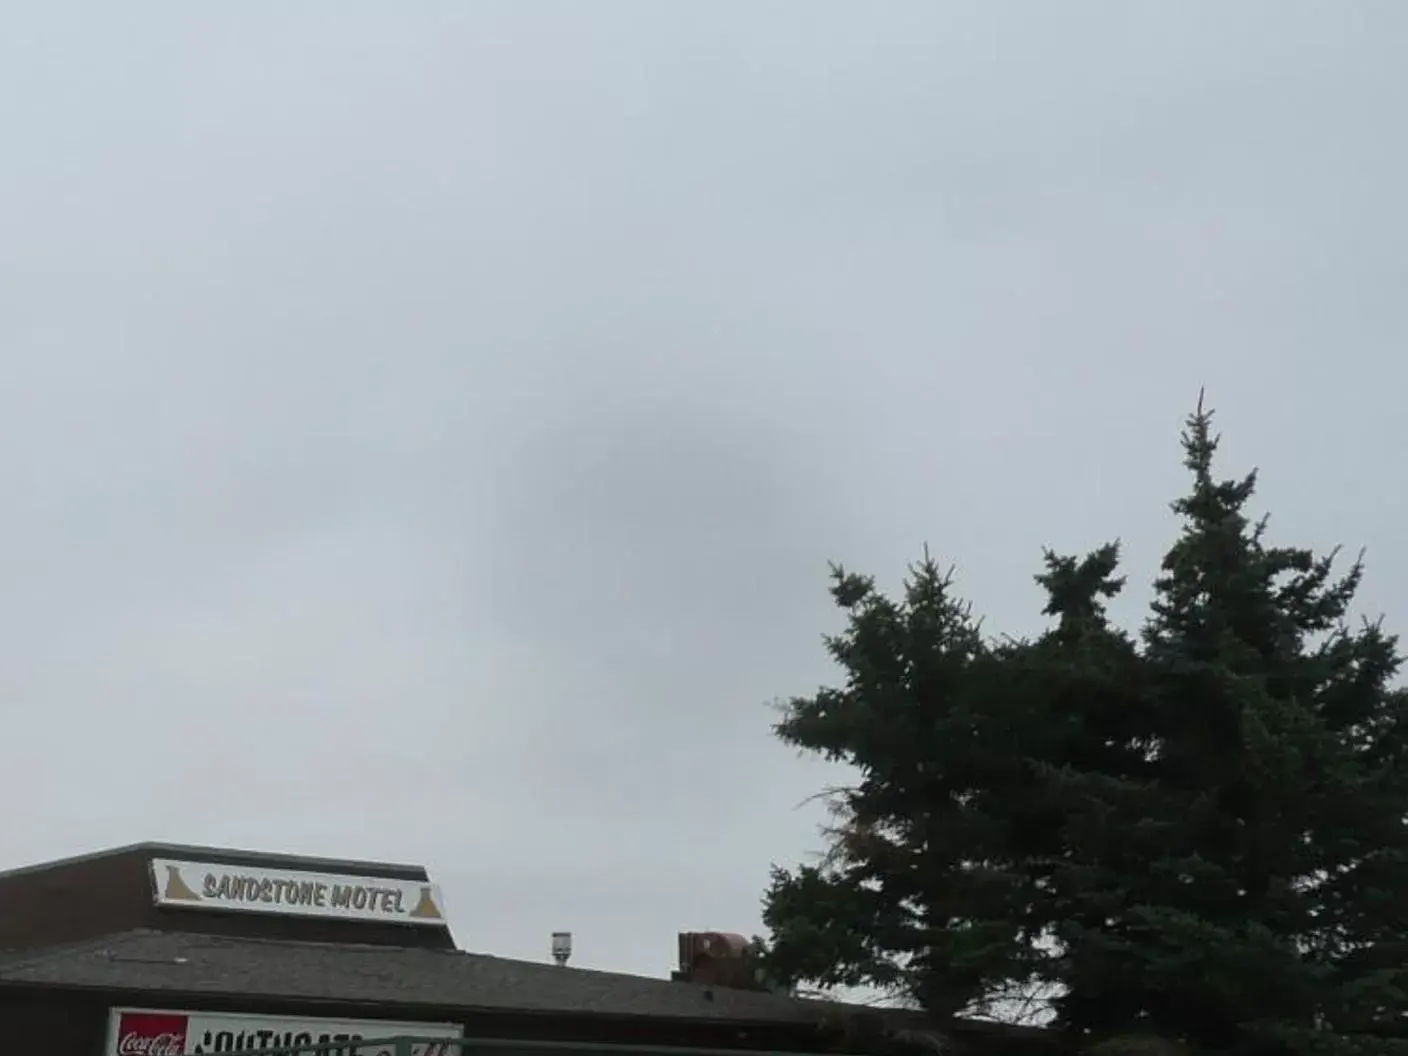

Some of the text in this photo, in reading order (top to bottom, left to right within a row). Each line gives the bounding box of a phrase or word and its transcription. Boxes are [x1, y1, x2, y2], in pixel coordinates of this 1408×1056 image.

[202, 872, 406, 913] SANDSTONE MOTEL
[119, 1030, 185, 1056] Coca-Cola
